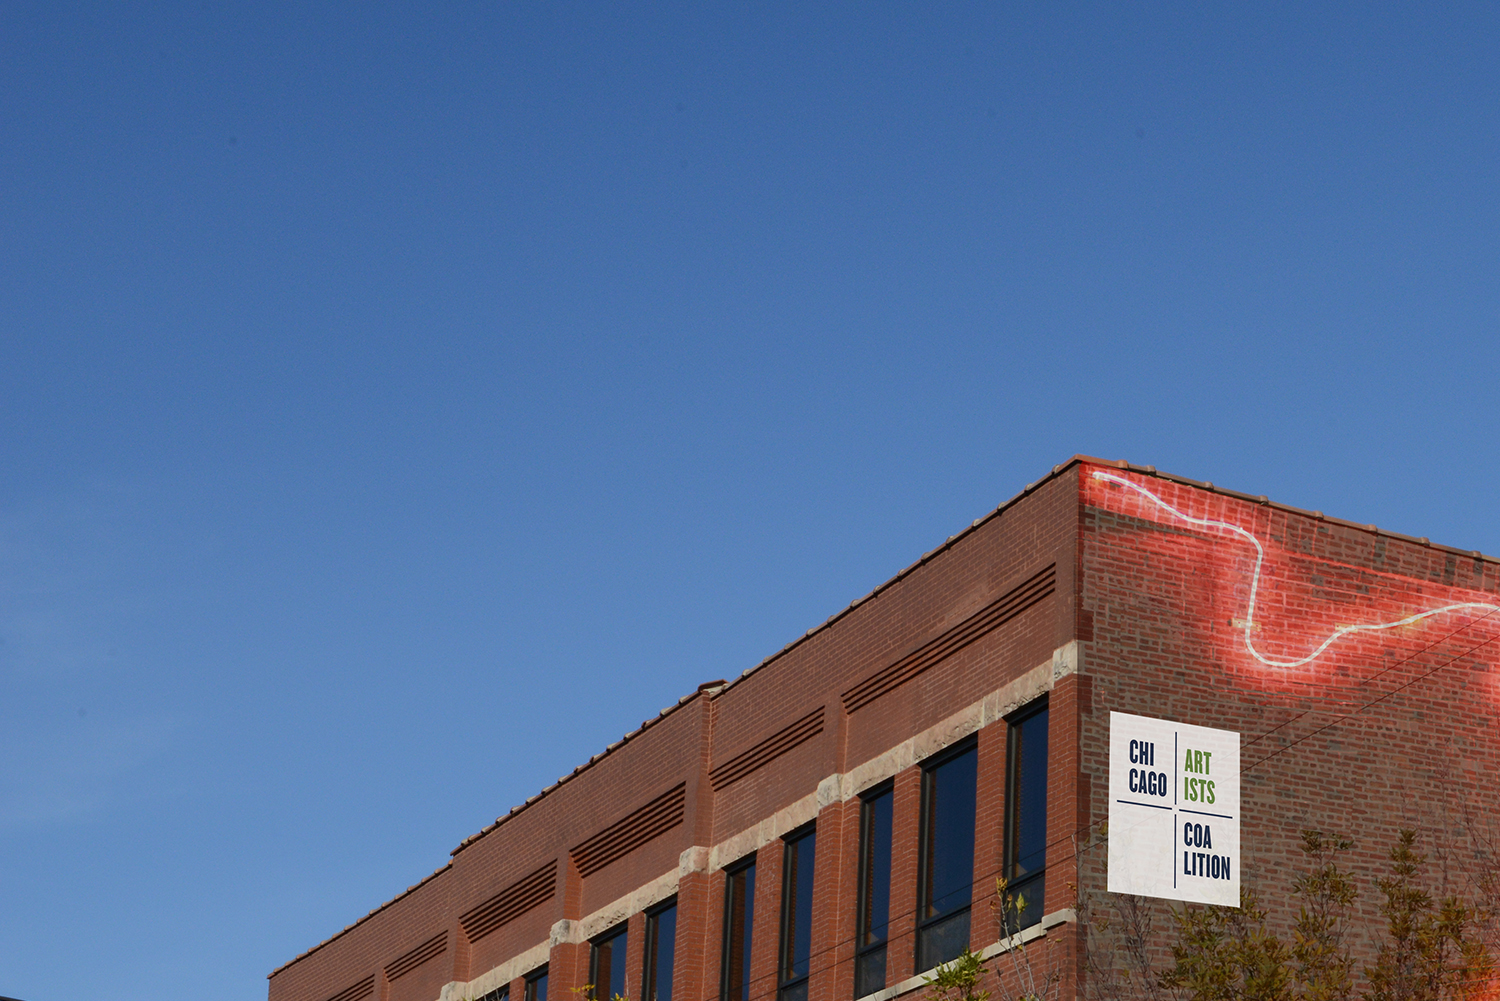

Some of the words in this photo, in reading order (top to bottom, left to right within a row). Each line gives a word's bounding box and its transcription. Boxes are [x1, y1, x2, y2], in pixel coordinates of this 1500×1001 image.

[1129, 739, 1154, 766] CHI
[1184, 749, 1212, 775] ART
[1129, 768, 1167, 797] CAGO
[1184, 777, 1215, 804] ISTS
[1184, 822, 1212, 849] COA
[1184, 851, 1231, 880] LITION
